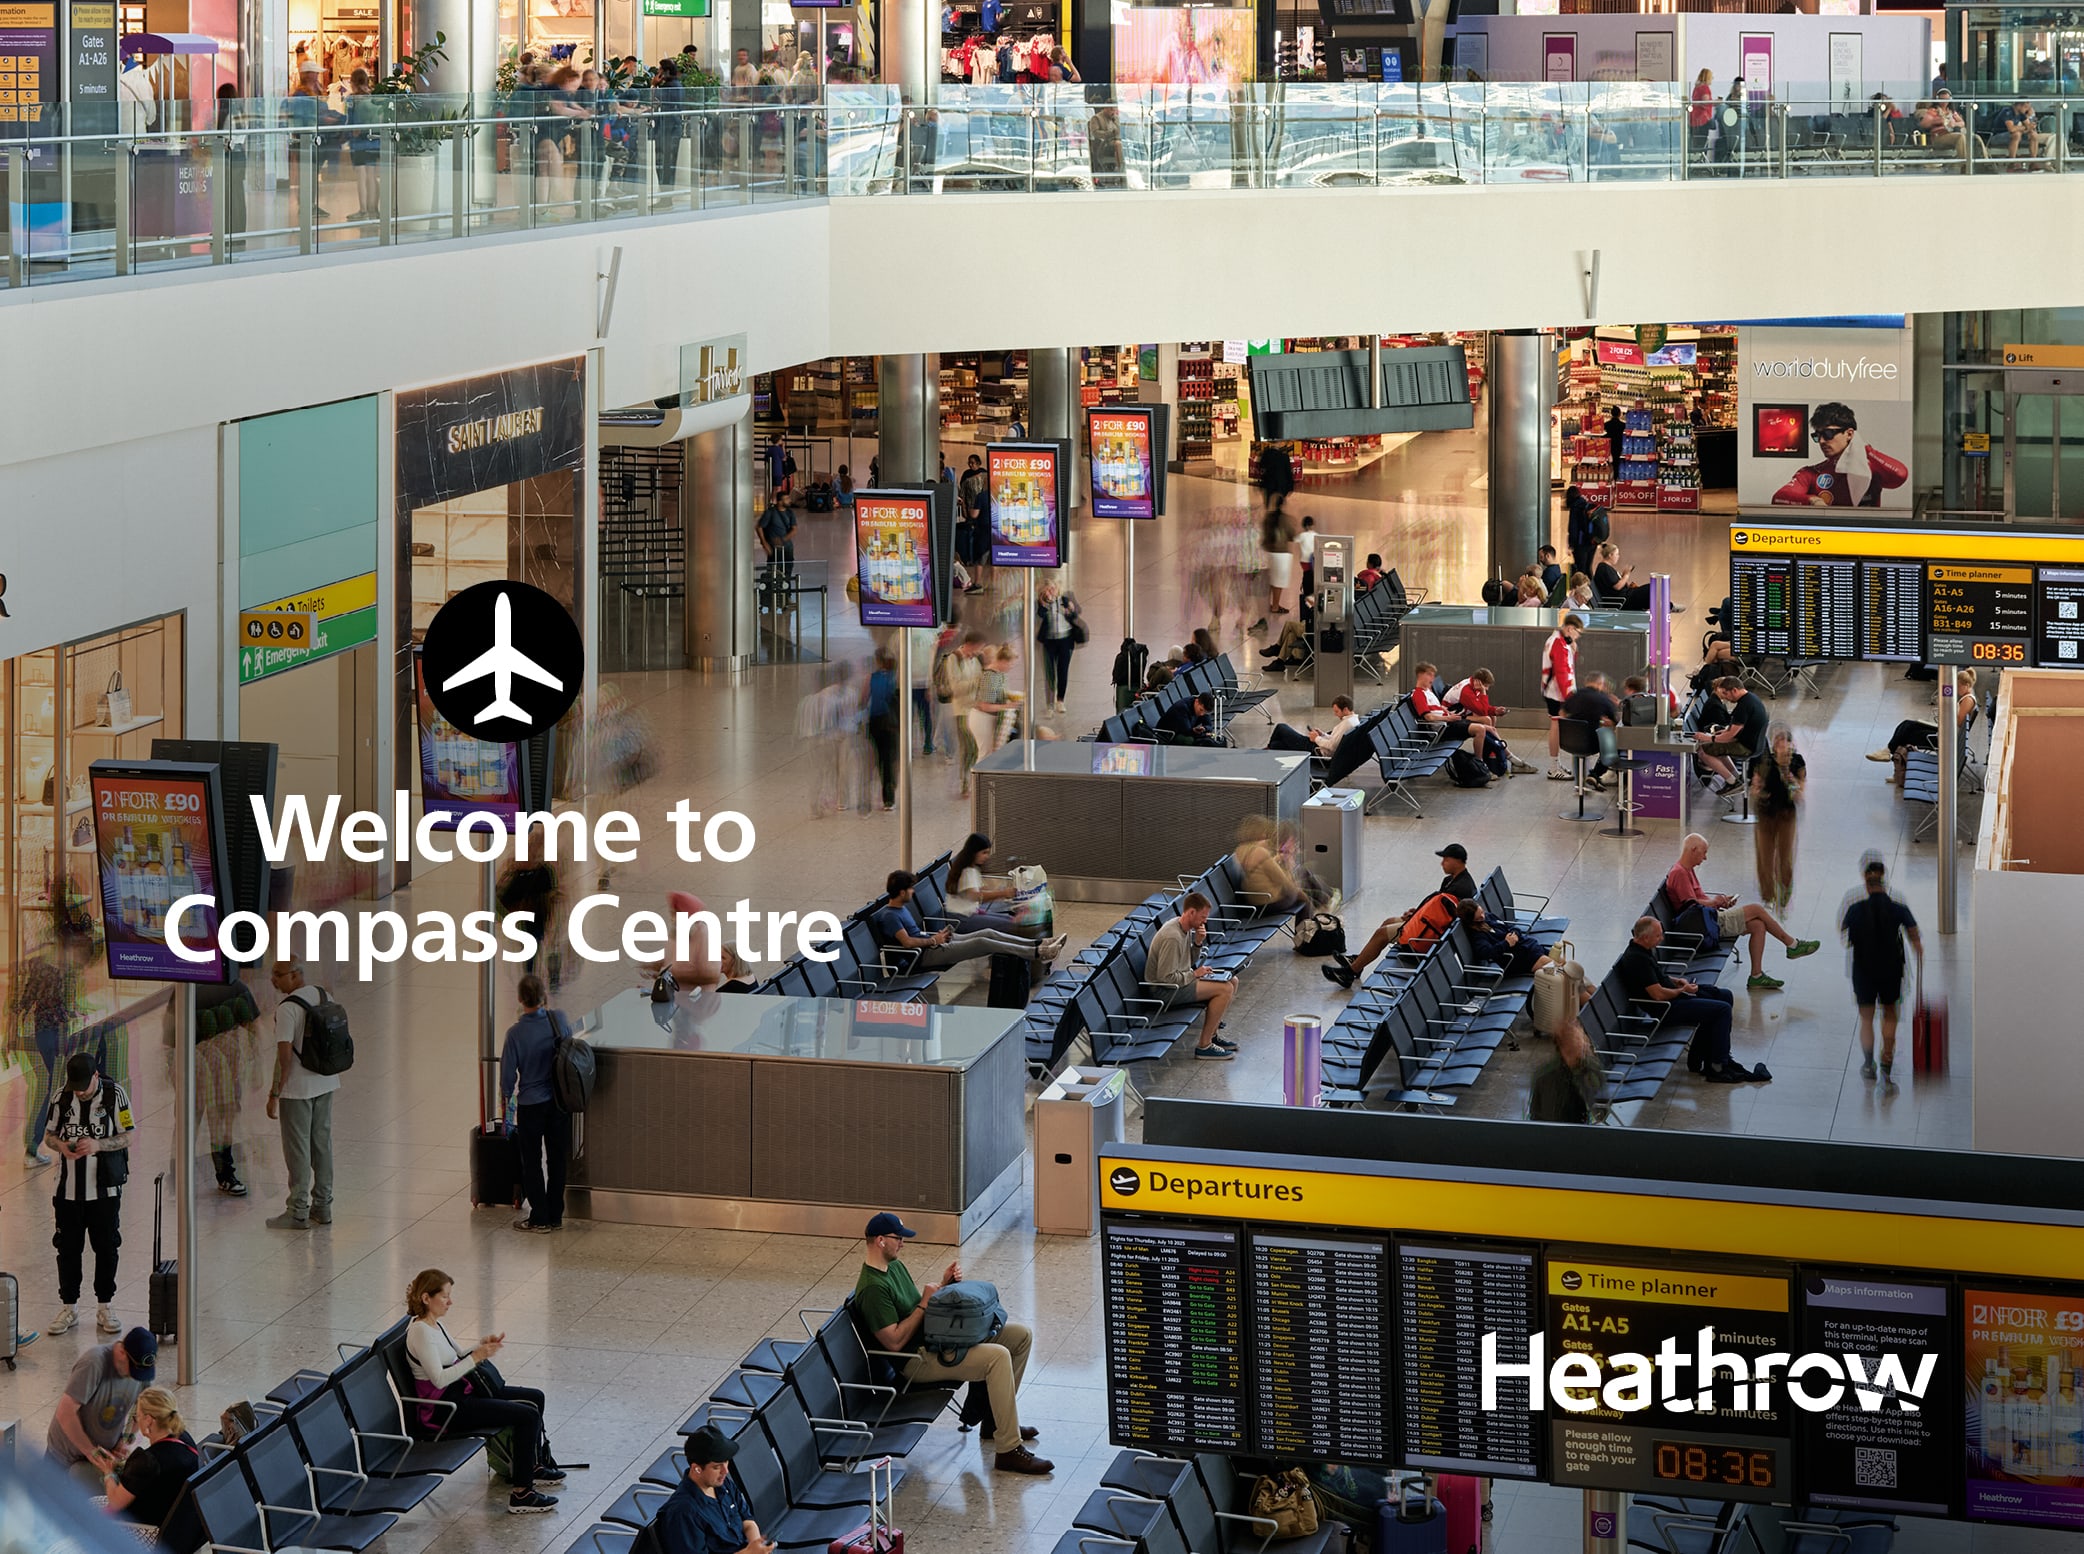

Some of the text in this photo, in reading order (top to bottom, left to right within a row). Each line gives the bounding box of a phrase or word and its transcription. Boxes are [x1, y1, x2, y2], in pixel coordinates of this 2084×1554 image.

[955, 4, 977, 12] FOOTBALL
[82, 34, 104, 48] Gates
[79, 52, 108, 66] A1-A26
[80, 84, 108, 94] 5 minutes
[179, 166, 213, 179] HEATOW
[179, 181, 207, 194] SOUS
[2018, 354, 2034, 362] Lift
[695, 345, 743, 401] Harrods
[448, 406, 544, 454] SAINT LAURENT
[1094, 420, 1100, 430] 2
[1126, 421, 1146, 431] £90
[993, 458, 1000, 469] 2
[1030, 460, 1052, 470] £90
[1821, 474, 1832, 488] hp
[1590, 494, 1608, 502] OFF
[1618, 491, 1655, 500] 50% OFF
[861, 507, 868, 518] 2
[901, 508, 924, 520] £90
[1752, 533, 1822, 546] Departures
[1946, 570, 2002, 580] Time planner
[1934, 588, 1964, 597] A1-A5
[1996, 590, 2027, 600] 5 minutes
[298, 597, 325, 613] Toilets
[1934, 604, 1974, 614] A16-A26
[1996, 606, 2001, 615] 5
[1934, 620, 1972, 629] B31-B49
[1990, 622, 2001, 630] 15
[1973, 643, 2024, 660] 08:36
[1656, 764, 1675, 773] Fast
[101, 790, 112, 808] 2
[164, 793, 200, 812] £90
[120, 954, 154, 963] Heathrow
[1150, 1171, 1304, 1202] Departures
[1134, 1236, 1156, 1244] Thursday,
[1270, 1247, 1300, 1255] Copenhagen
[1134, 1254, 1150, 1262] Friday,
[1416, 1258, 1438, 1266] Bangkok
[1270, 1264, 1292, 1272] Frankfurt
[1588, 1273, 1718, 1298] Time planner
[1825, 1284, 1914, 1300] Maps information
[1427, 1302, 1446, 1310] Angeles
[1562, 1302, 1590, 1312] Gates
[1562, 1313, 1630, 1334] A1-A5
[1824, 1320, 1838, 1328] For
[1852, 1324, 1897, 1334] up-to-date
[1898, 1328, 1918, 1336] map
[1918, 1328, 1928, 1336] of
[1720, 1332, 1776, 1346] minutes
[1824, 1331, 1928, 1346] this terminal, please scan
[1562, 1339, 1594, 1351] Gates
[1824, 1340, 1878, 1352] this QR code:
[1721, 1408, 1778, 1420] minutes
[1885, 1408, 1904, 1418] App
[1826, 1412, 1923, 1428] offers step-by-step map
[1826, 1422, 1869, 1432] directions.
[1870, 1426, 1886, 1434] Use
[1887, 1427, 1902, 1435] this
[1904, 1428, 1920, 1436] link
[1565, 1429, 1632, 1443] Please allow
[1826, 1432, 1922, 1446] choose your download:
[1565, 1440, 1634, 1454] enough time
[1566, 1450, 1637, 1466] to reach your
[1566, 1462, 1590, 1472] gate
[1658, 1444, 1772, 1487] 08:36
[1978, 1492, 2022, 1504] Heathrow
